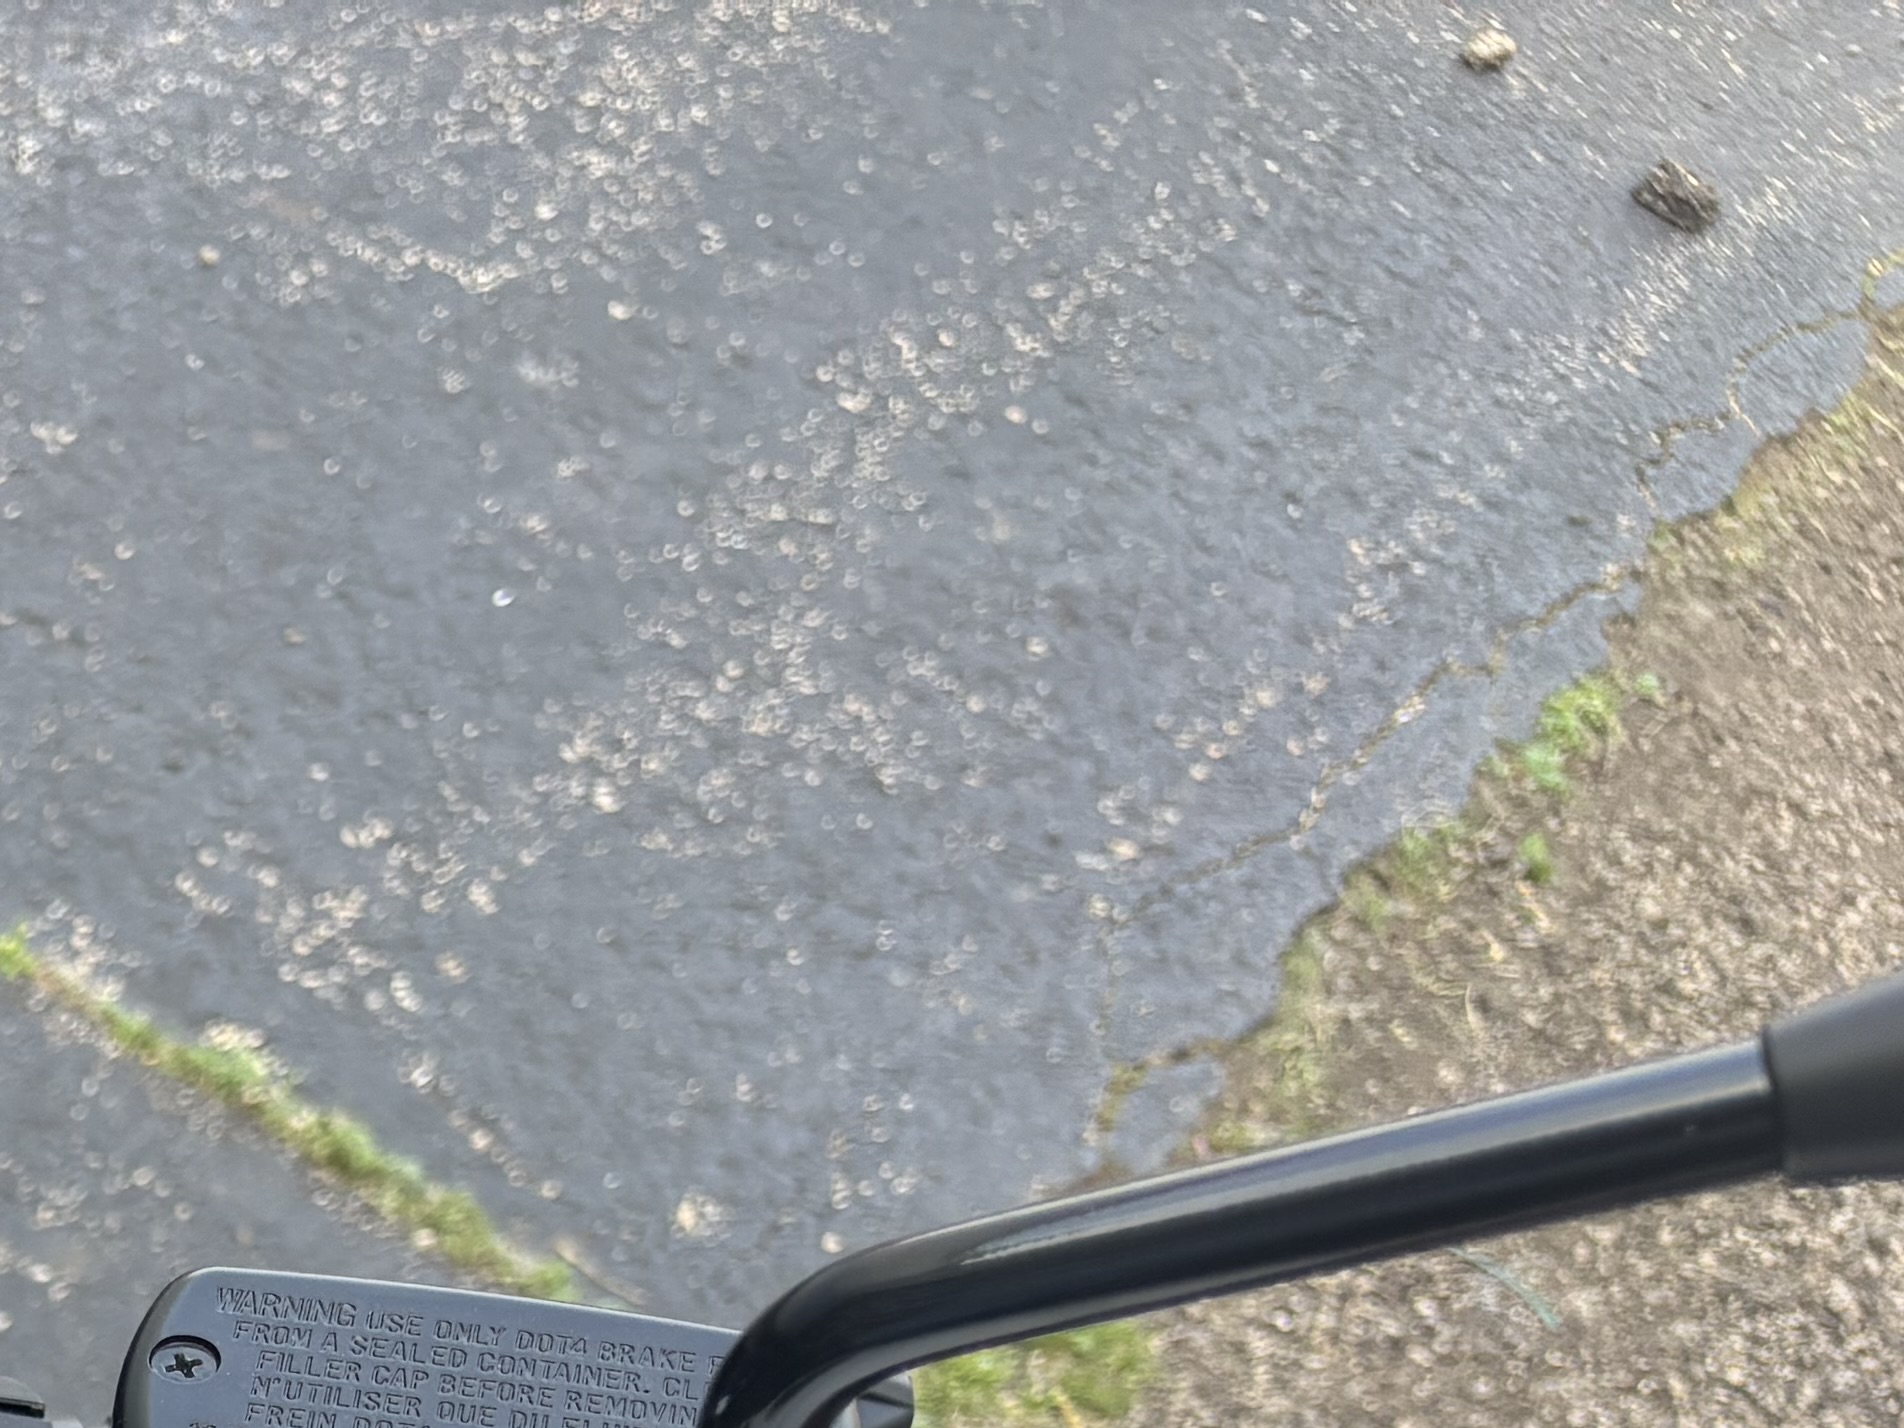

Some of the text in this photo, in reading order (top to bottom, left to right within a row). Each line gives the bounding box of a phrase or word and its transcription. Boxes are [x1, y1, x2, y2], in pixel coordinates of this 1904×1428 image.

[217, 1287, 357, 1327] WARNING
[366, 1311, 424, 1337] USE
[433, 1319, 507, 1347] ONLY
[515, 1329, 587, 1355] DOT4
[598, 1340, 696, 1373] BRAKE
[233, 1320, 313, 1349] FROM
[320, 1331, 338, 1353] A
[350, 1335, 468, 1369] SEALED
[477, 1350, 651, 1395] CONTAINER.
[249, 1376, 422, 1418] N'UTILISER
[436, 1400, 497, 1428] QUE
[255, 1349, 698, 1428] FILLER CAP BEFORE REMOVIN
